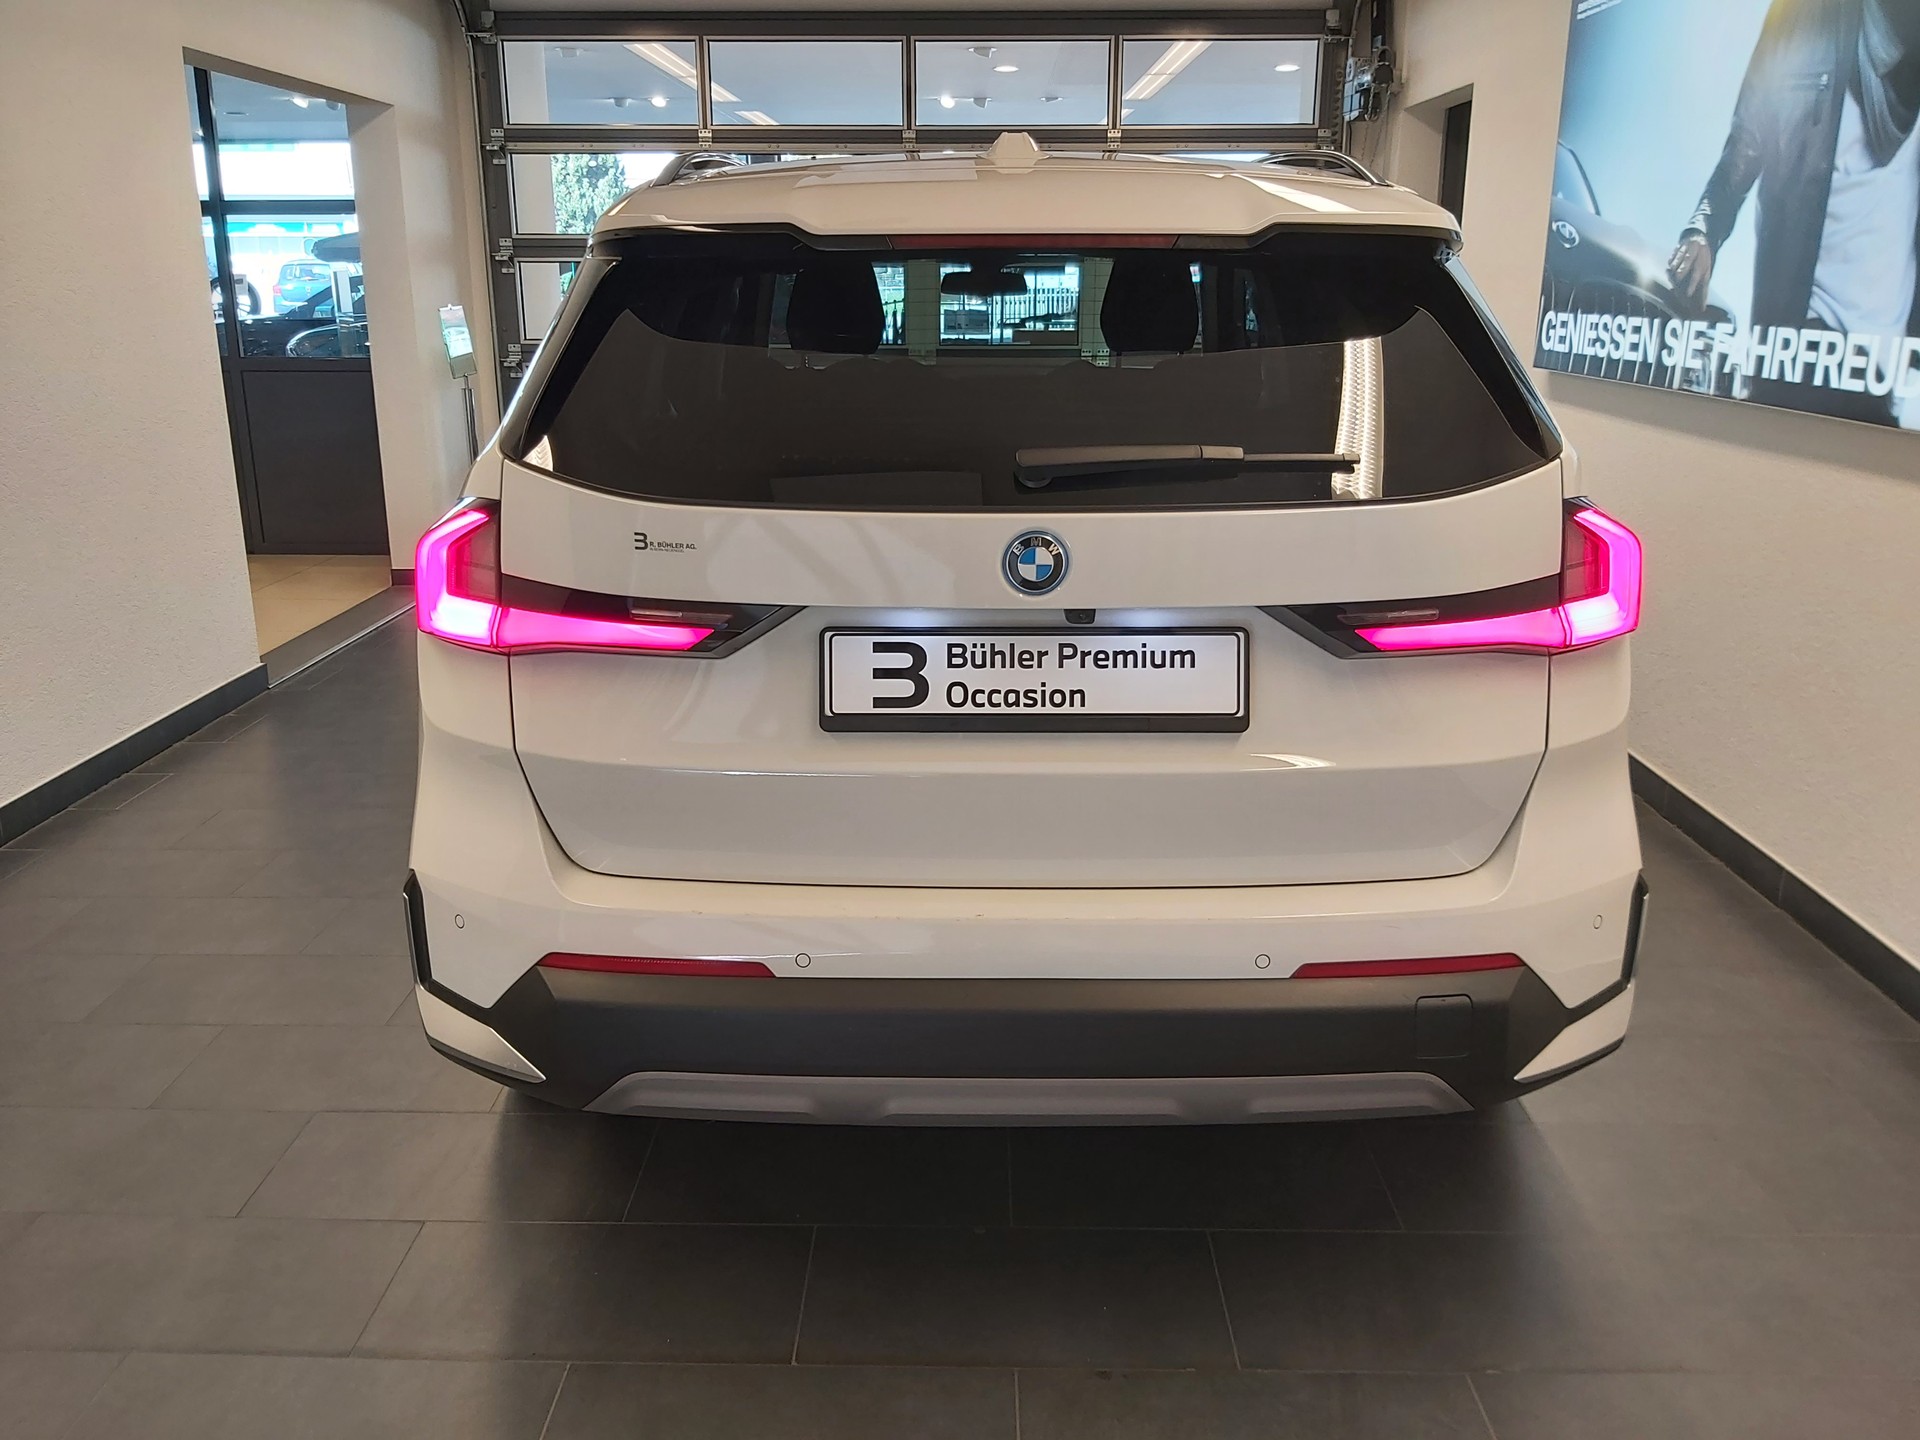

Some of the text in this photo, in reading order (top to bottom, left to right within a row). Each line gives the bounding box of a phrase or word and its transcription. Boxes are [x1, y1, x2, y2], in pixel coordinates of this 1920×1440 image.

[1541, 310, 1660, 364] GENIESSEN
[1663, 318, 1707, 370] SIE
[657, 541, 684, 549] BÜHLER
[1012, 537, 1061, 556] BMW
[946, 642, 1196, 669] Bühler Premium
[945, 680, 1087, 708] Occasion
